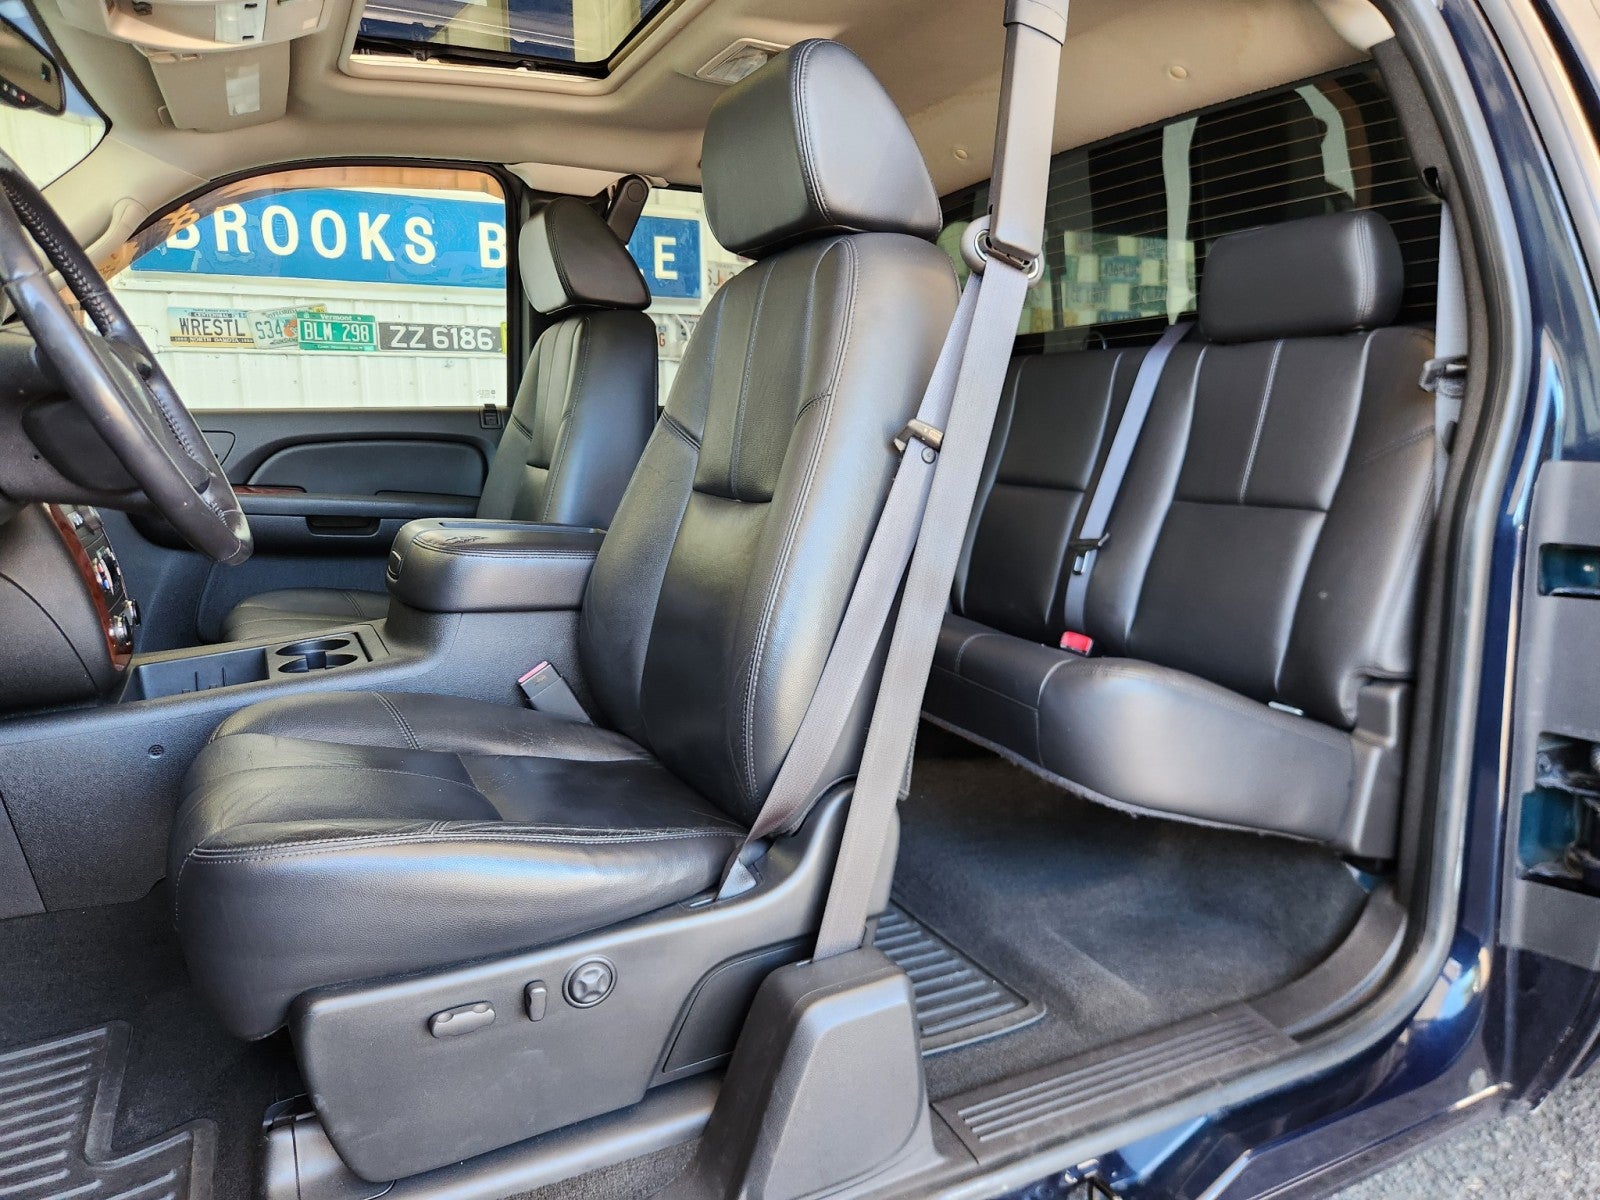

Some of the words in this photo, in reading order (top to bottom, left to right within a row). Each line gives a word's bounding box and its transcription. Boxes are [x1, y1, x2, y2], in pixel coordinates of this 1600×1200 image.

[166, 204, 437, 265] BROOKS
[179, 317, 246, 336] WRESTL
[320, 313, 352, 321] Vermont
[303, 321, 333, 341] BLM
[341, 324, 370, 342] 298
[389, 325, 426, 349] ZZ
[432, 326, 494, 351] 6186
